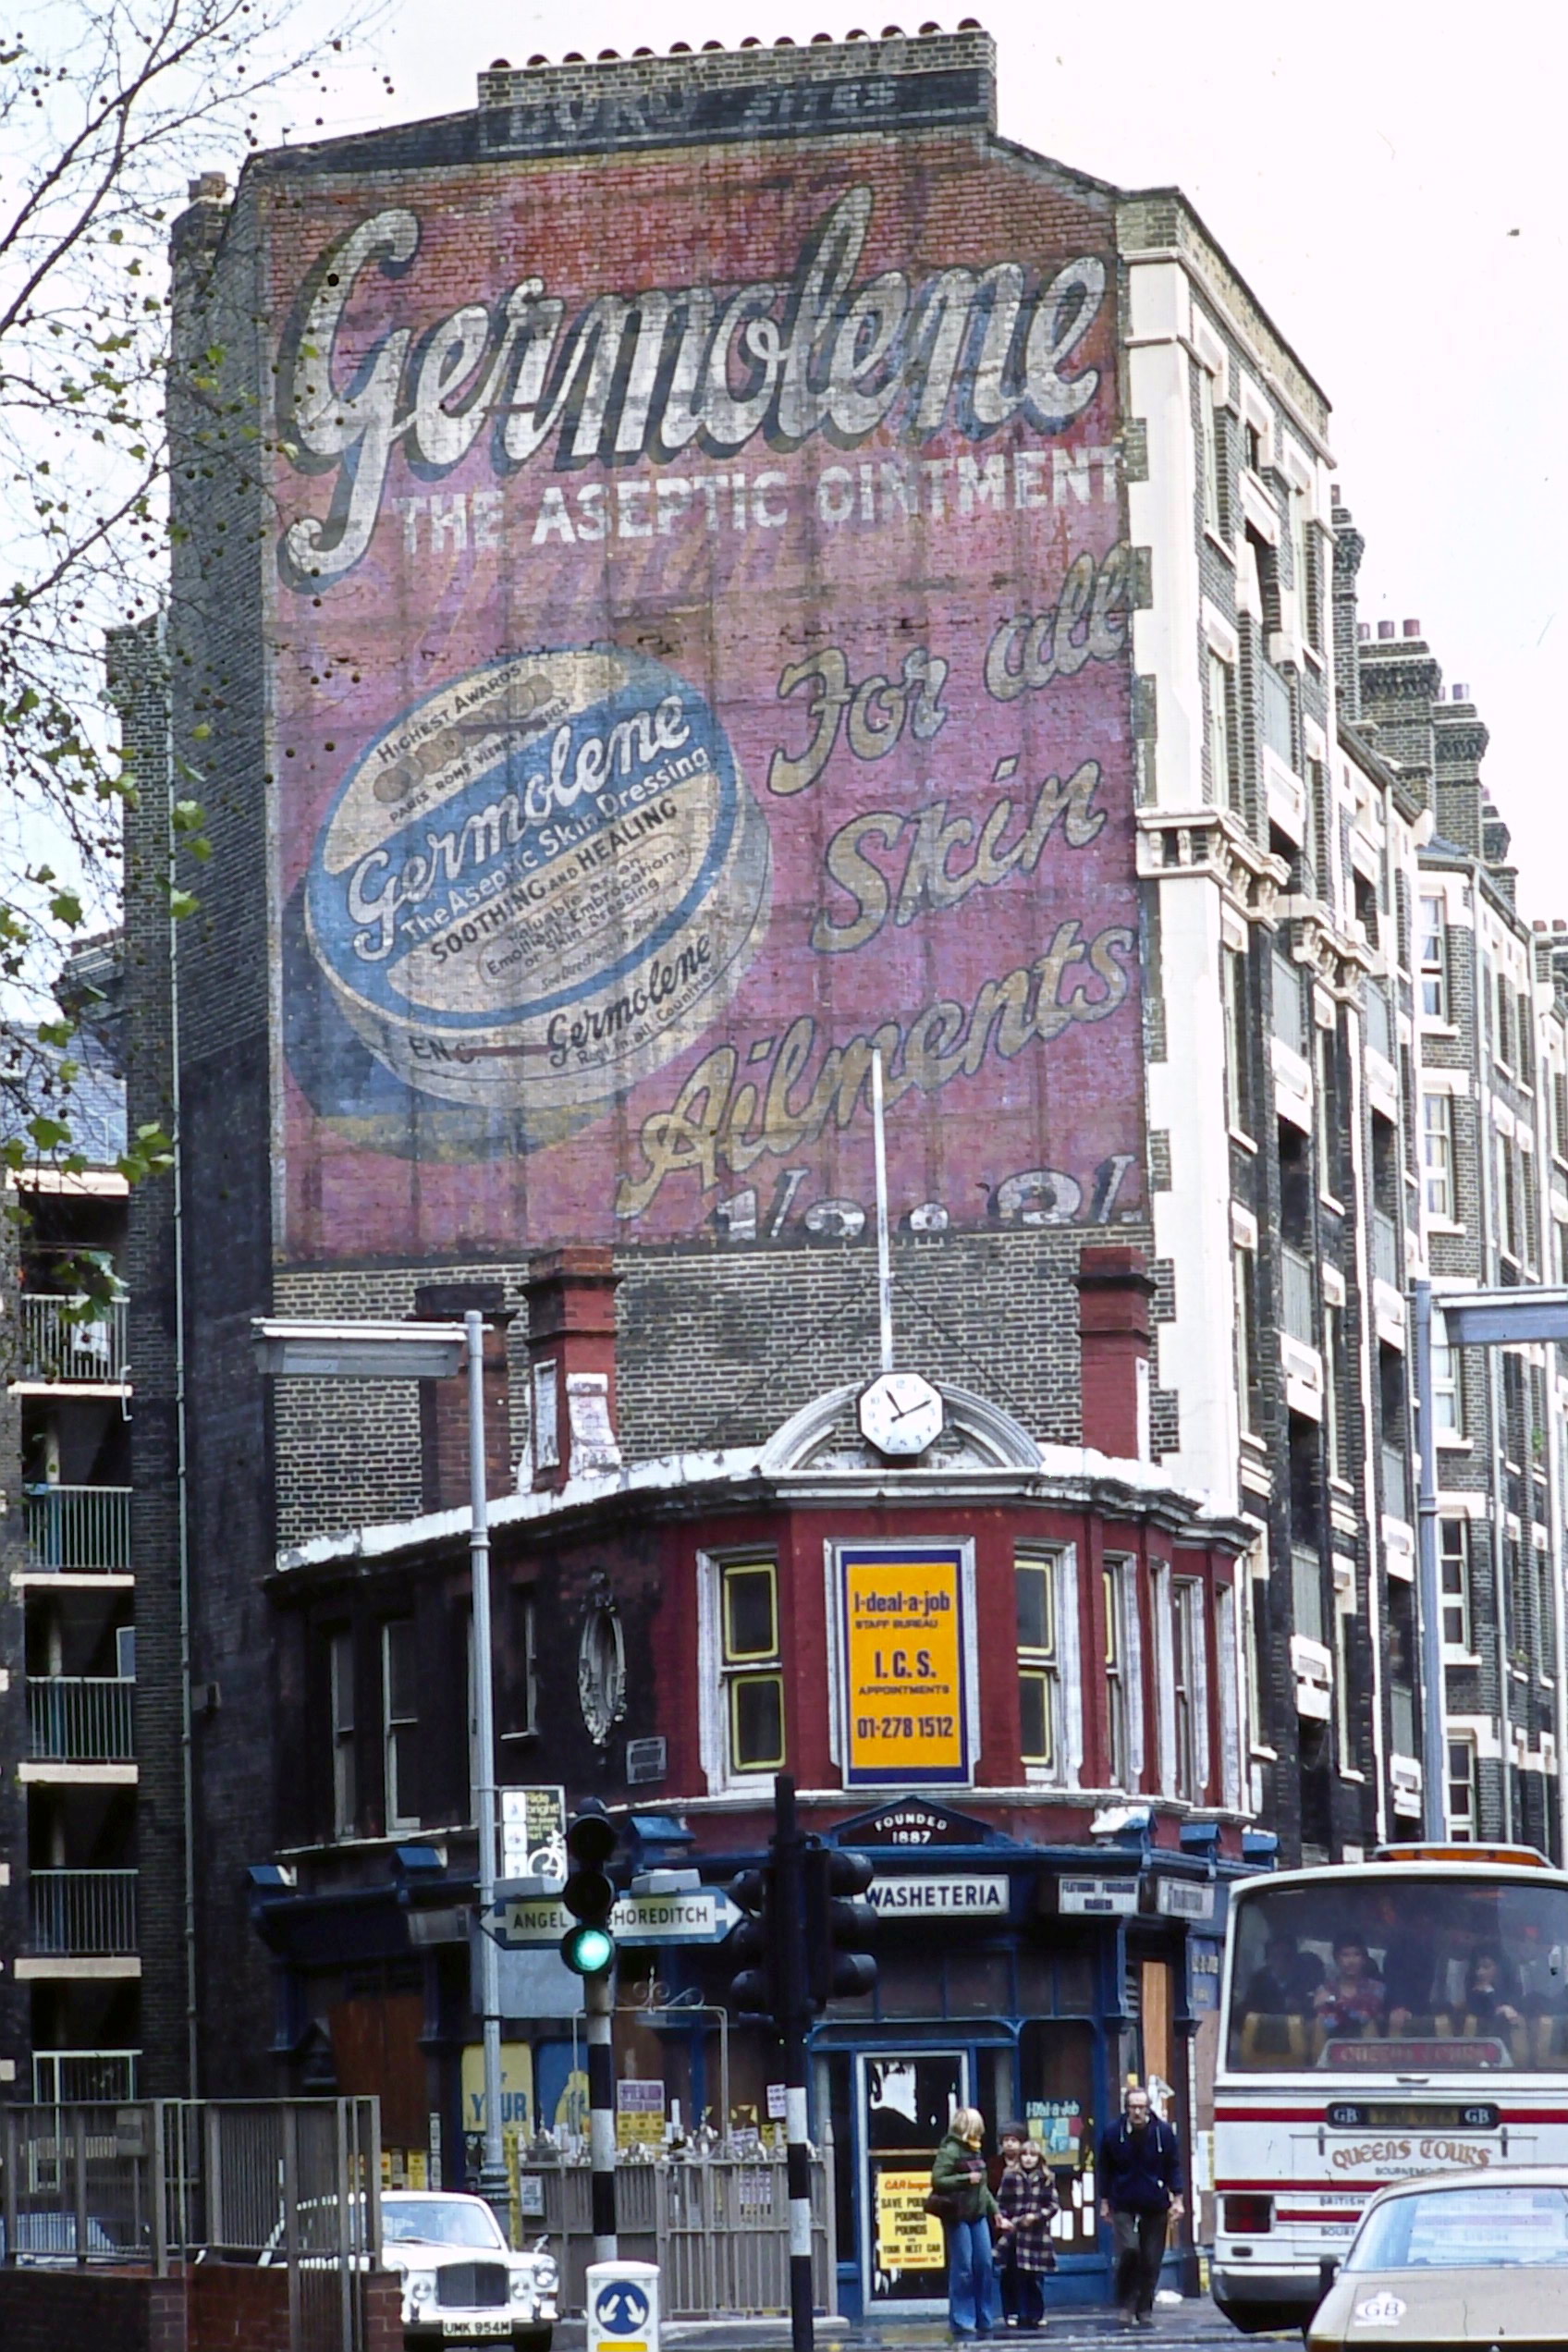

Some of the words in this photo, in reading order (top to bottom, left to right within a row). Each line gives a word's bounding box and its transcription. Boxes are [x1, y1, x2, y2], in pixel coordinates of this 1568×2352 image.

[282, 185, 1108, 582] Germolene
[391, 490, 504, 554] THE
[531, 470, 789, 545] ASEPTIC
[817, 446, 1119, 522] OINTMENT
[767, 647, 949, 796] For
[984, 540, 1133, 703] all
[389, 790, 430, 823] PARIS
[435, 763, 472, 791] ROME
[348, 695, 691, 962] Germolene
[399, 909, 450, 941] The
[447, 850, 539, 916] Aseptic
[537, 812, 599, 857] Skin
[596, 747, 710, 818] Dressing
[808, 754, 1107, 953] Skin
[430, 877, 547, 964] SOOTHING
[549, 864, 579, 891] AND
[574, 797, 679, 872] HEALING
[508, 892, 582, 942] Valuable
[524, 953, 540, 969] or
[545, 929, 582, 955] Skin
[587, 877, 660, 928] Dressing
[547, 935, 711, 1068] Germolene
[656, 967, 718, 1023] Countries
[615, 921, 1133, 1219] Ailments
[855, 1620, 890, 1630] STAFF
[892, 1619, 939, 1630] BUREAU
[858, 1684, 950, 1696] APPOINTMENTS
[857, 1717, 913, 1740] 01-278
[918, 1716, 954, 1739] 1512
[875, 1813, 949, 1832] FOUNDED
[891, 1830, 932, 1844] 1887
[513, 1912, 570, 1929] ANGEL
[864, 1884, 1001, 1909] WASHETERIA
[471, 2092, 527, 2123] YUR
[1333, 2107, 1359, 2125] GB
[1464, 2108, 1490, 2125] GB
[1331, 2140, 1412, 2171] QUEENS
[1419, 2138, 1492, 2169] TOURS
[1365, 2301, 1399, 2317] GB
